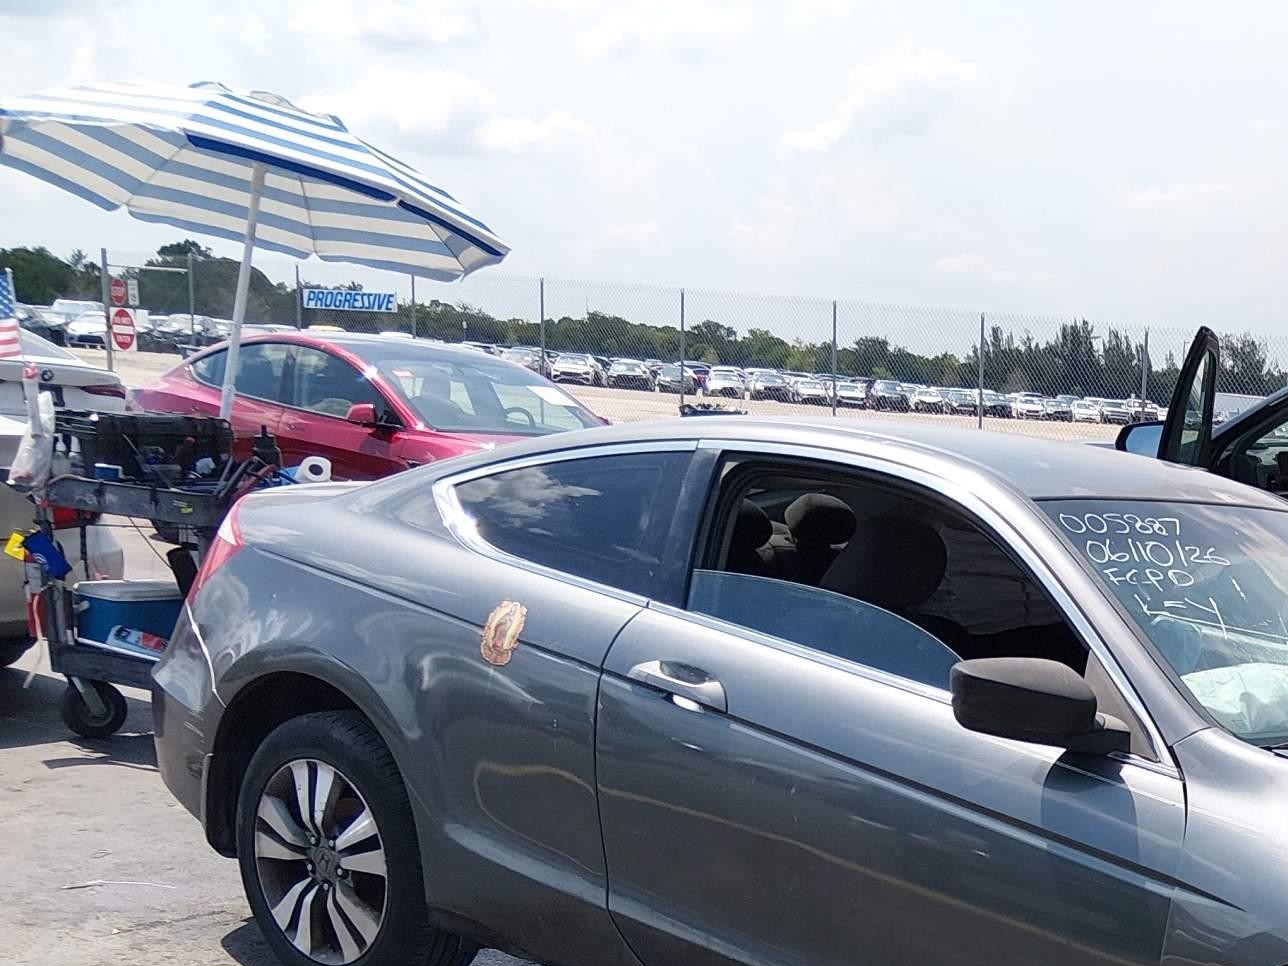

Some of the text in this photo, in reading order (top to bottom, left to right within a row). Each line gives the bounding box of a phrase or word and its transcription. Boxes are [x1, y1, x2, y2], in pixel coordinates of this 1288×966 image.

[306, 290, 395, 311] PROGRESSIVE
[1059, 513, 1180, 536] 005887
[1086, 538, 1231, 567] 06/10/26
